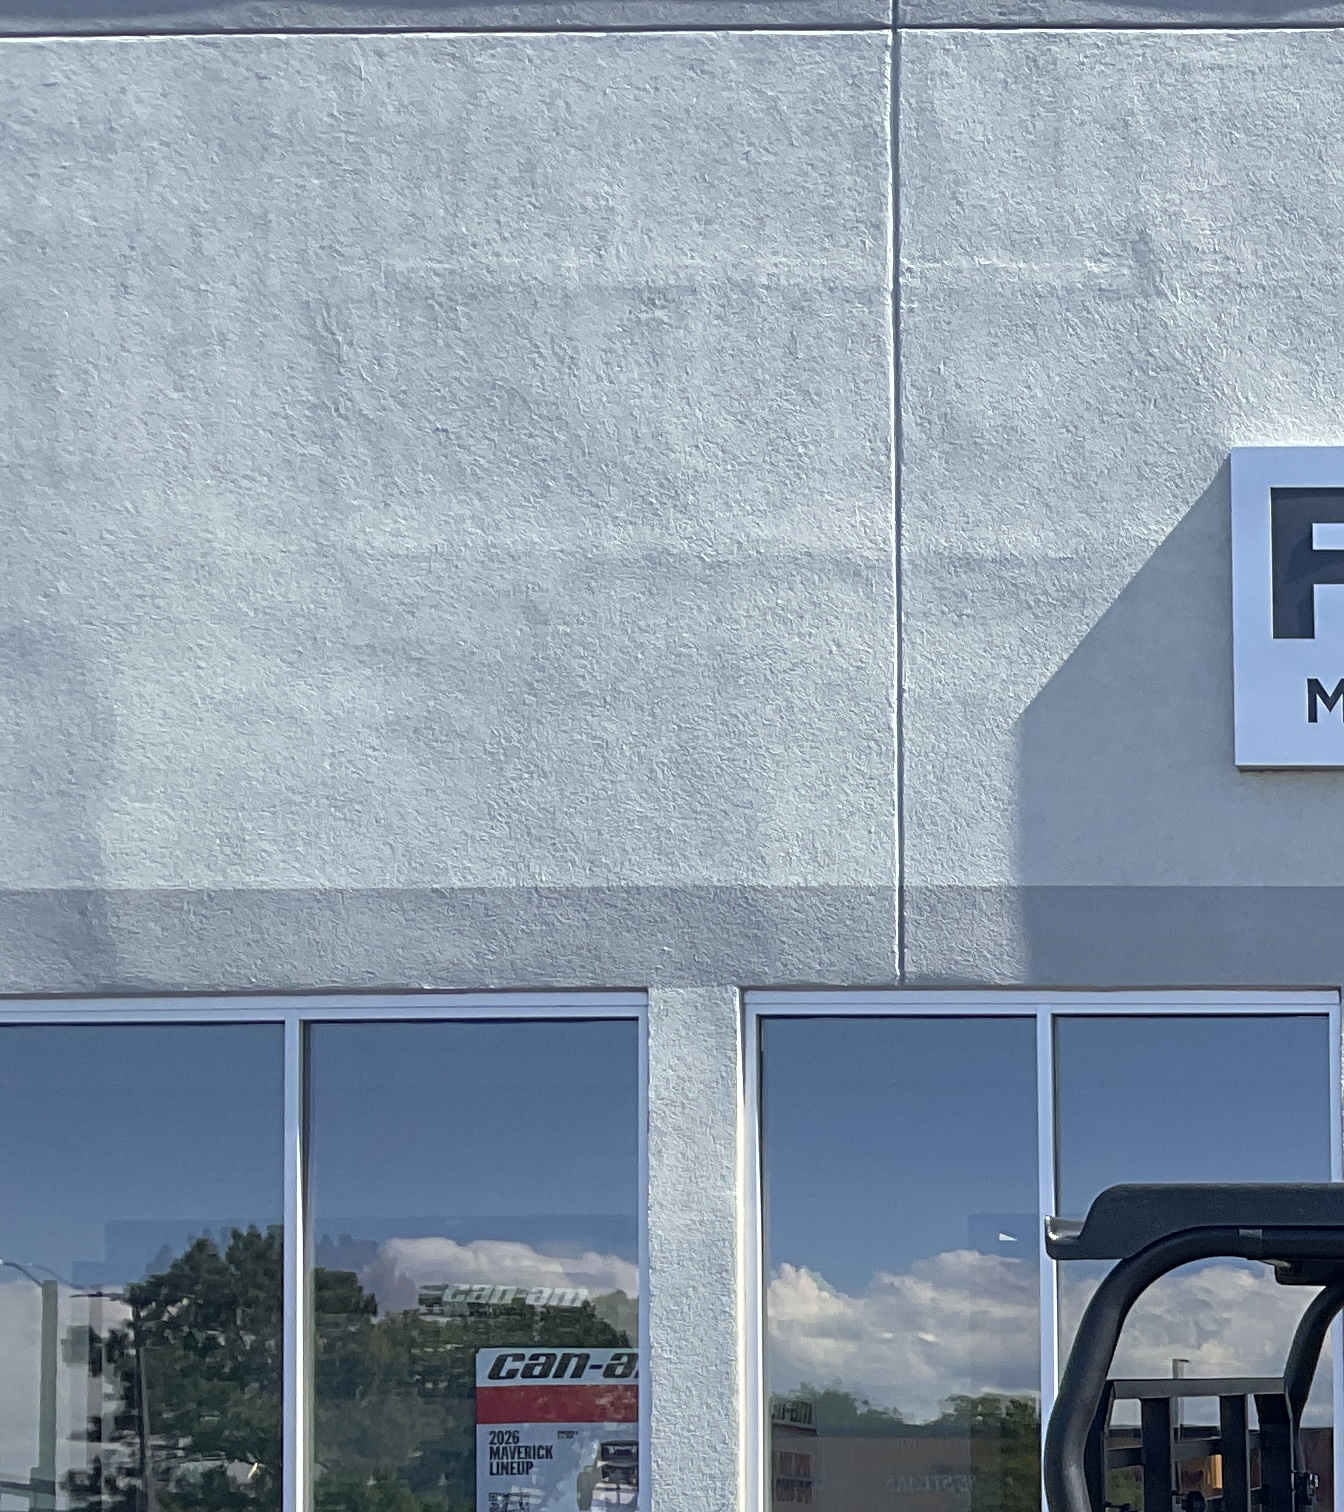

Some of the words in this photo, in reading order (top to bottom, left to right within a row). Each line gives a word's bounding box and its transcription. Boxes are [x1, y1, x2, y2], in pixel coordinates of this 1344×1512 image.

[441, 1283, 589, 1307] can-am
[487, 1352, 639, 1380] can-a
[489, 1430, 520, 1445] 2026
[489, 1445, 554, 1460] MAVERICK
[489, 1461, 534, 1476] LINEUP
